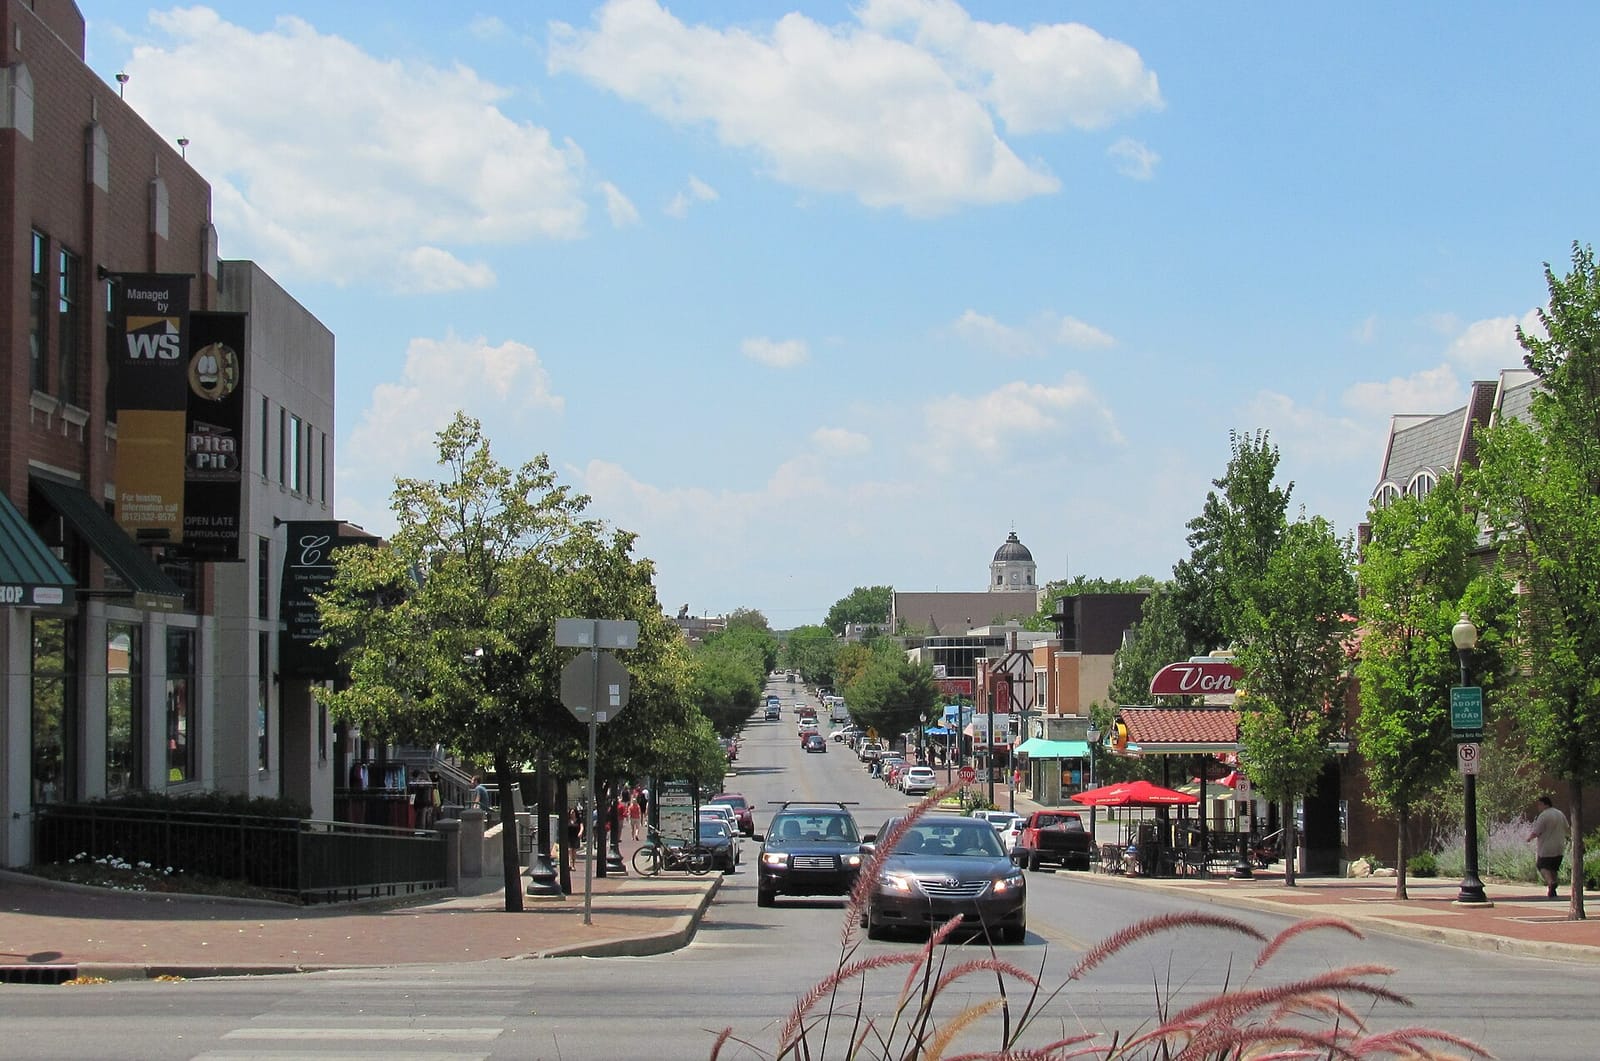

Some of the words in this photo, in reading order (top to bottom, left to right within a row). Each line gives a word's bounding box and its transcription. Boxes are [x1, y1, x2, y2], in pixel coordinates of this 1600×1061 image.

[127, 289, 169, 301] Managed
[157, 302, 169, 312] by
[126, 334, 180, 359] WS
[191, 436, 234, 451] Pita
[197, 453, 227, 468] Pit
[184, 516, 209, 526] OPEN
[211, 516, 234, 526] LATE
[960, 770, 974, 779] STOP
